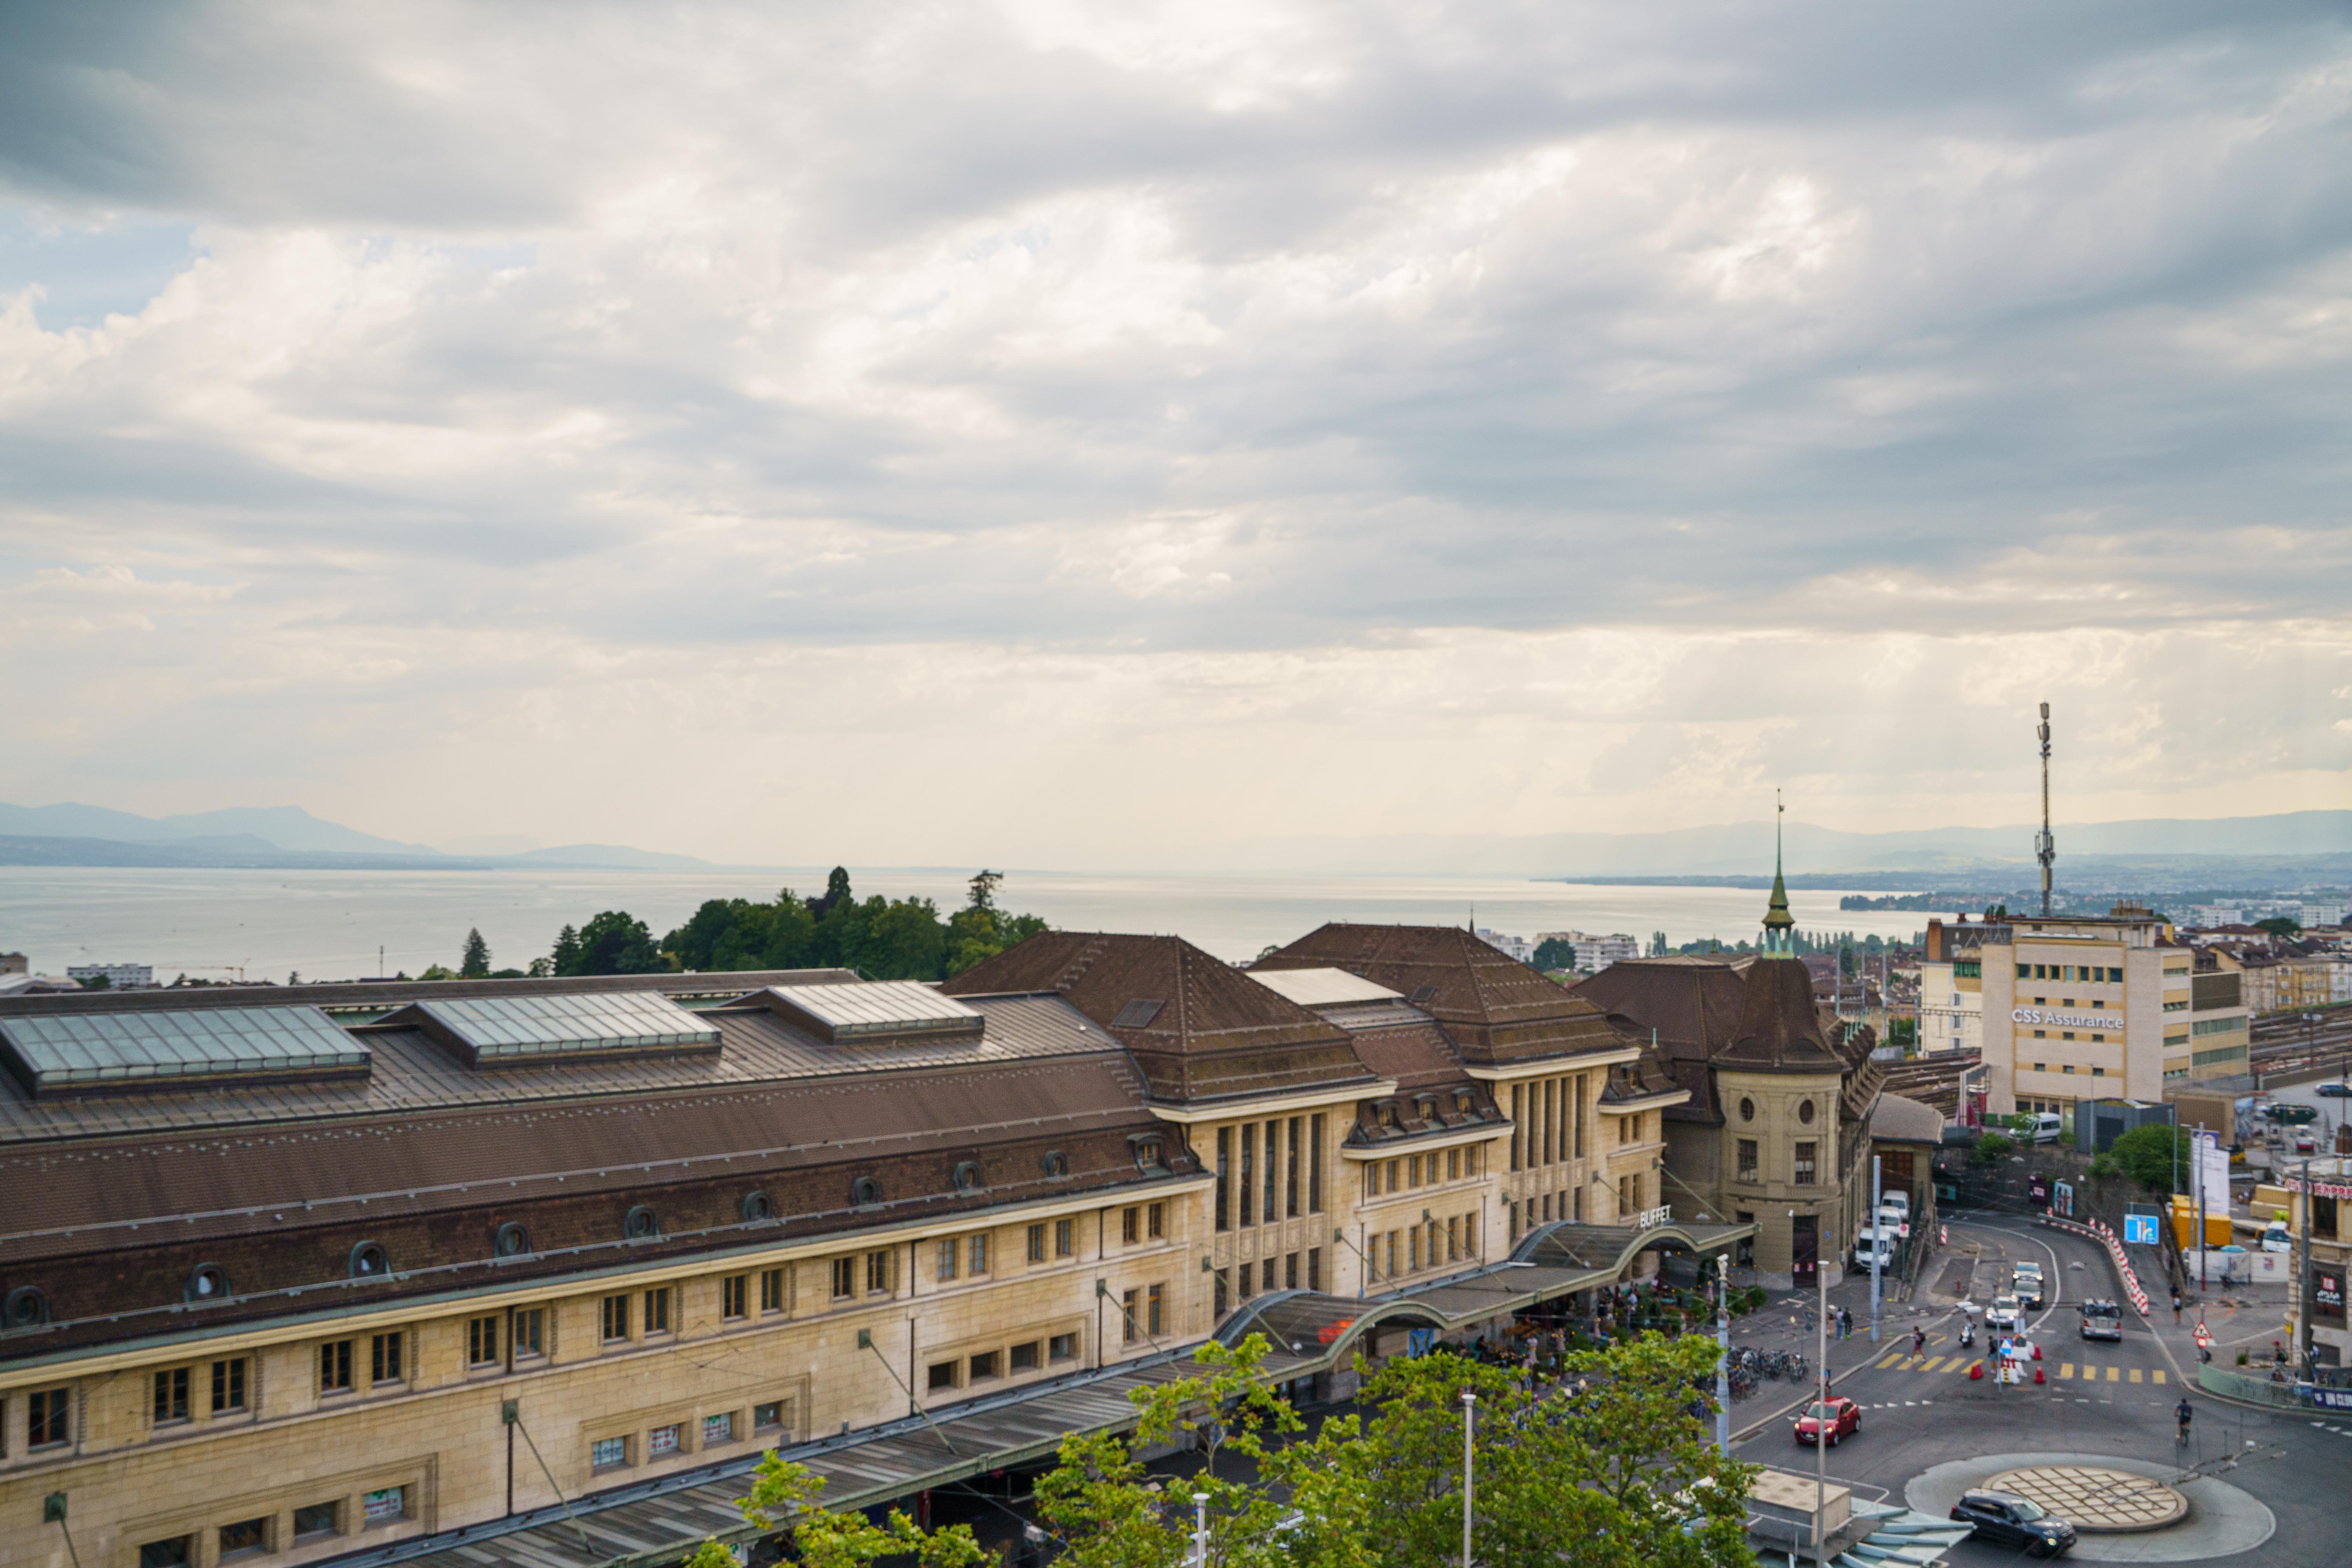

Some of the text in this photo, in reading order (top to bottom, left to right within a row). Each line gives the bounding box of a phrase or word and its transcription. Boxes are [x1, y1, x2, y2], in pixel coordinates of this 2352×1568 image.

[2012, 1009, 2125, 1029] CSS Assurance
[1640, 1204, 1671, 1228] BUFFET
